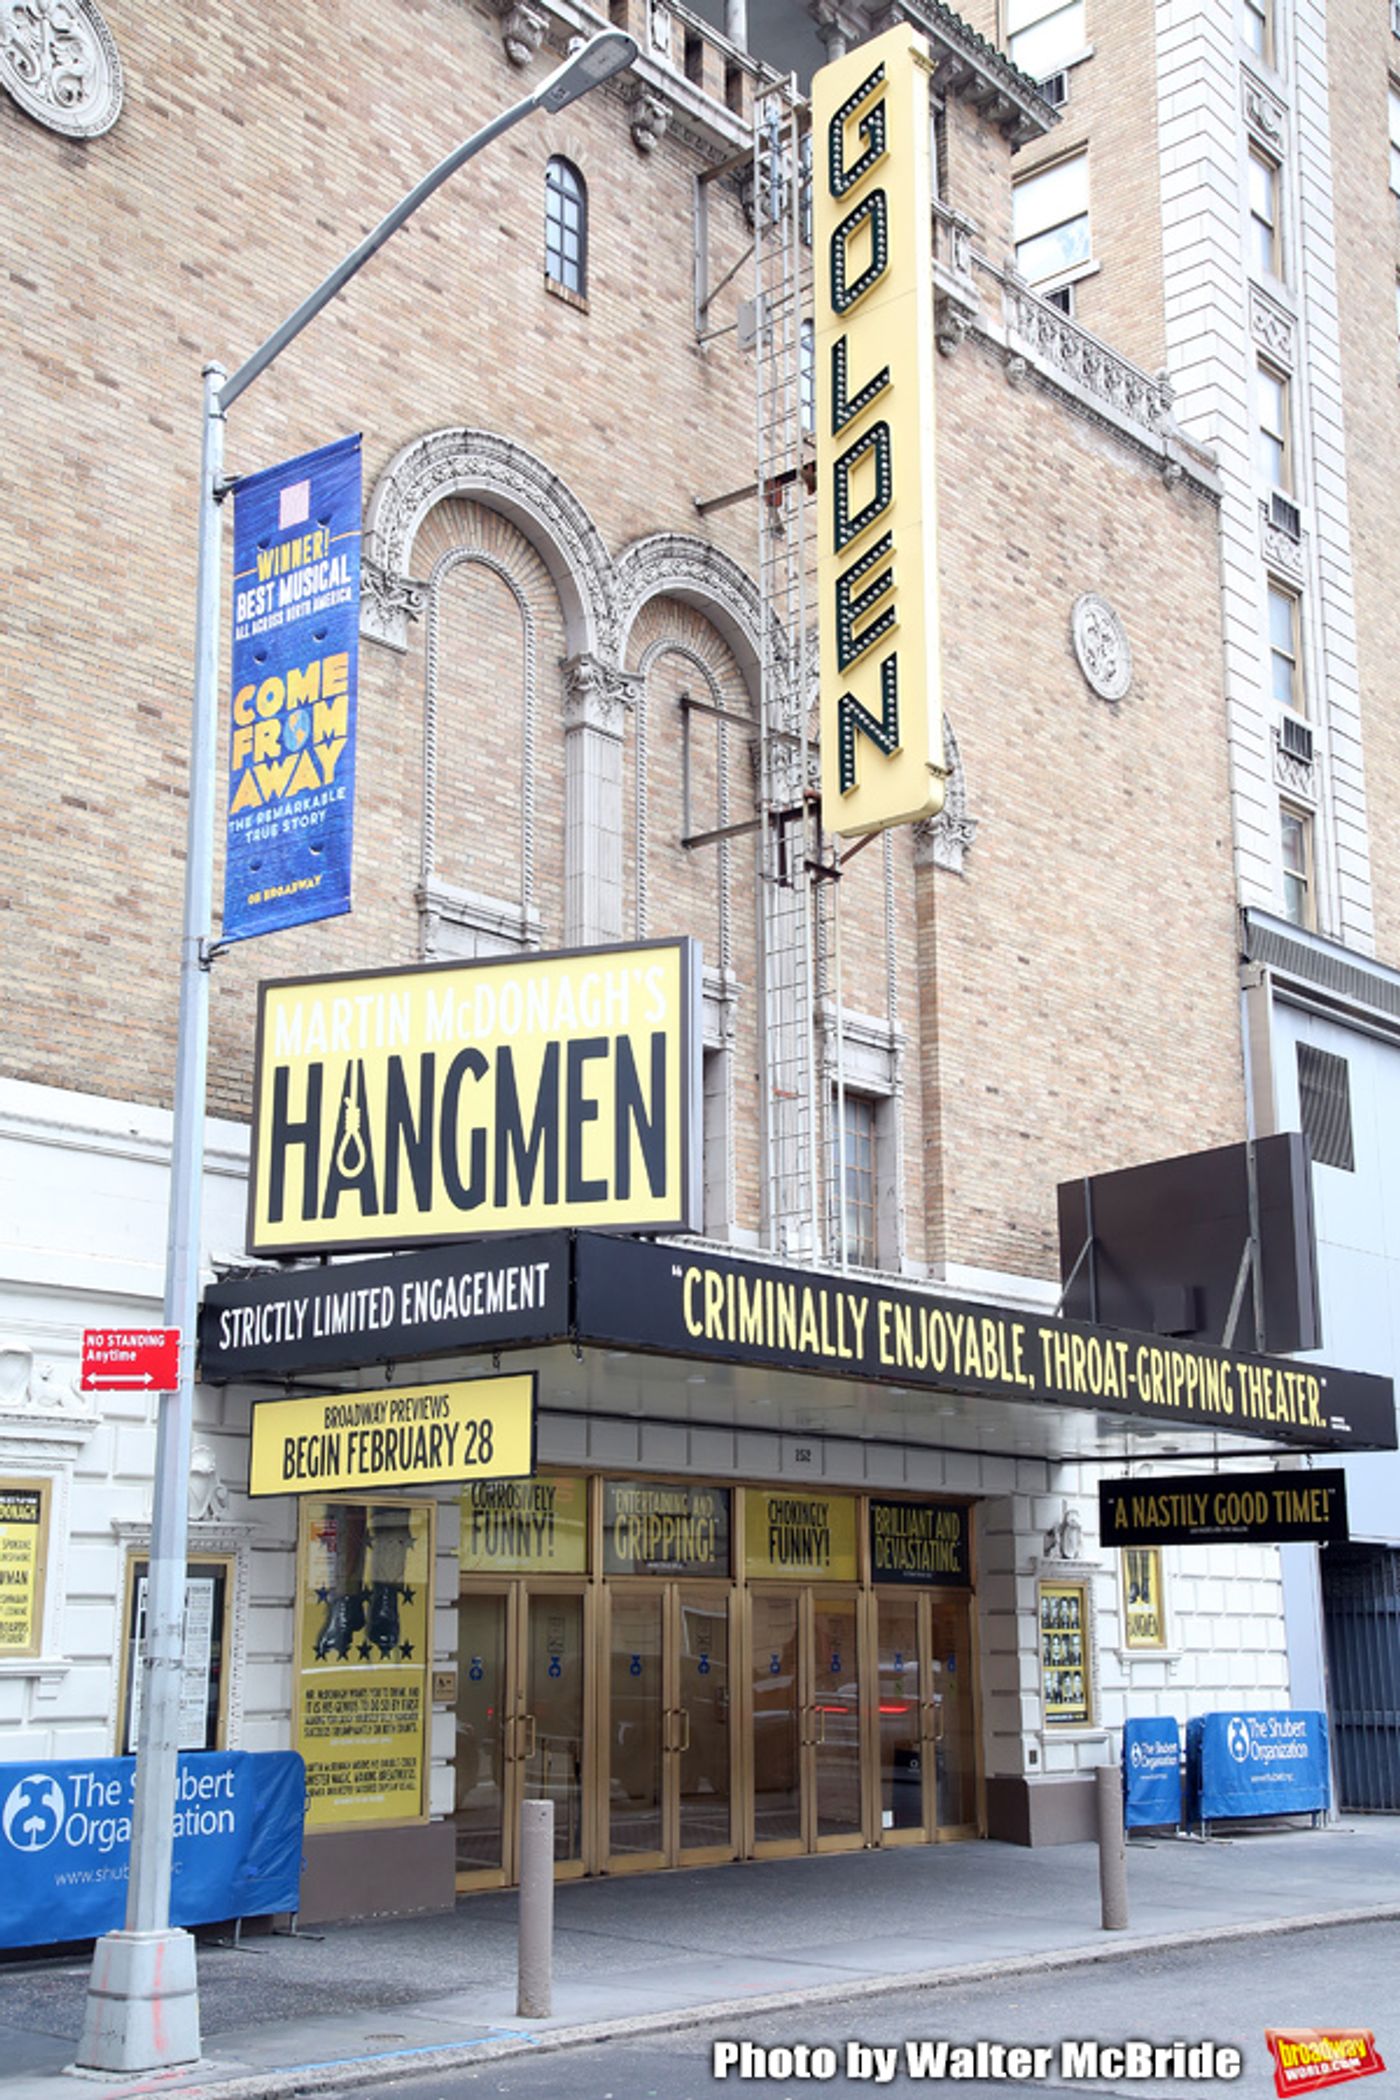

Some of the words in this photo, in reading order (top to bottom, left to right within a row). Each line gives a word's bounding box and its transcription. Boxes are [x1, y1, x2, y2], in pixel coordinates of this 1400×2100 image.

[828, 59, 901, 796] GOLDEN
[256, 527, 330, 582] WINNER!
[236, 582, 290, 622] BEST
[279, 554, 351, 607] MUSICAL
[235, 622, 252, 641] ALL
[252, 611, 284, 635] ACROSS
[286, 600, 312, 622] NORTH
[313, 587, 352, 612] AMERICA
[233, 651, 349, 728] COME
[231, 694, 348, 772] FROM
[229, 737, 346, 815] AWAY
[229, 815, 253, 833] THE
[256, 786, 346, 825] REMARKABLE
[246, 824, 279, 843] TRUE
[282, 809, 328, 832] STORY
[264, 874, 324, 901] BROADWAY
[274, 990, 412, 1057] MARTIN
[425, 964, 668, 1043] McDONAGH'S
[267, 1031, 667, 1224] HANGMEN
[218, 1298, 310, 1351] STRICTLY
[312, 1285, 395, 1338] LIMITED
[400, 1262, 551, 1326] ENGAGEMENT
[86, 1334, 105, 1347] NO
[107, 1334, 166, 1348] STANDING
[86, 1348, 138, 1364] Anytime
[672, 1264, 868, 1360] "CRIMINALLY
[877, 1299, 1035, 1390] ENJOYABLE,
[1038, 1327, 1233, 1415] THROAT-GRIPPING
[324, 1400, 390, 1430] BROADWAY
[389, 1393, 450, 1424] PREVIEWS
[282, 1433, 341, 1481] BEGIN
[347, 1421, 459, 1475] FEBRUARY
[463, 1418, 494, 1466] 28
[692, 1496, 714, 1518] AND
[935, 1511, 961, 1542] AND
[1132, 1493, 1209, 1528] NASTILY
[1213, 1490, 1269, 1526] GOOD
[1248, 1717, 1269, 1738] The
[1268, 1717, 1307, 1739] Shubert
[1250, 1739, 1309, 1765] Organization
[67, 1772, 123, 1808] The
[65, 1803, 235, 1853] Orgaation
